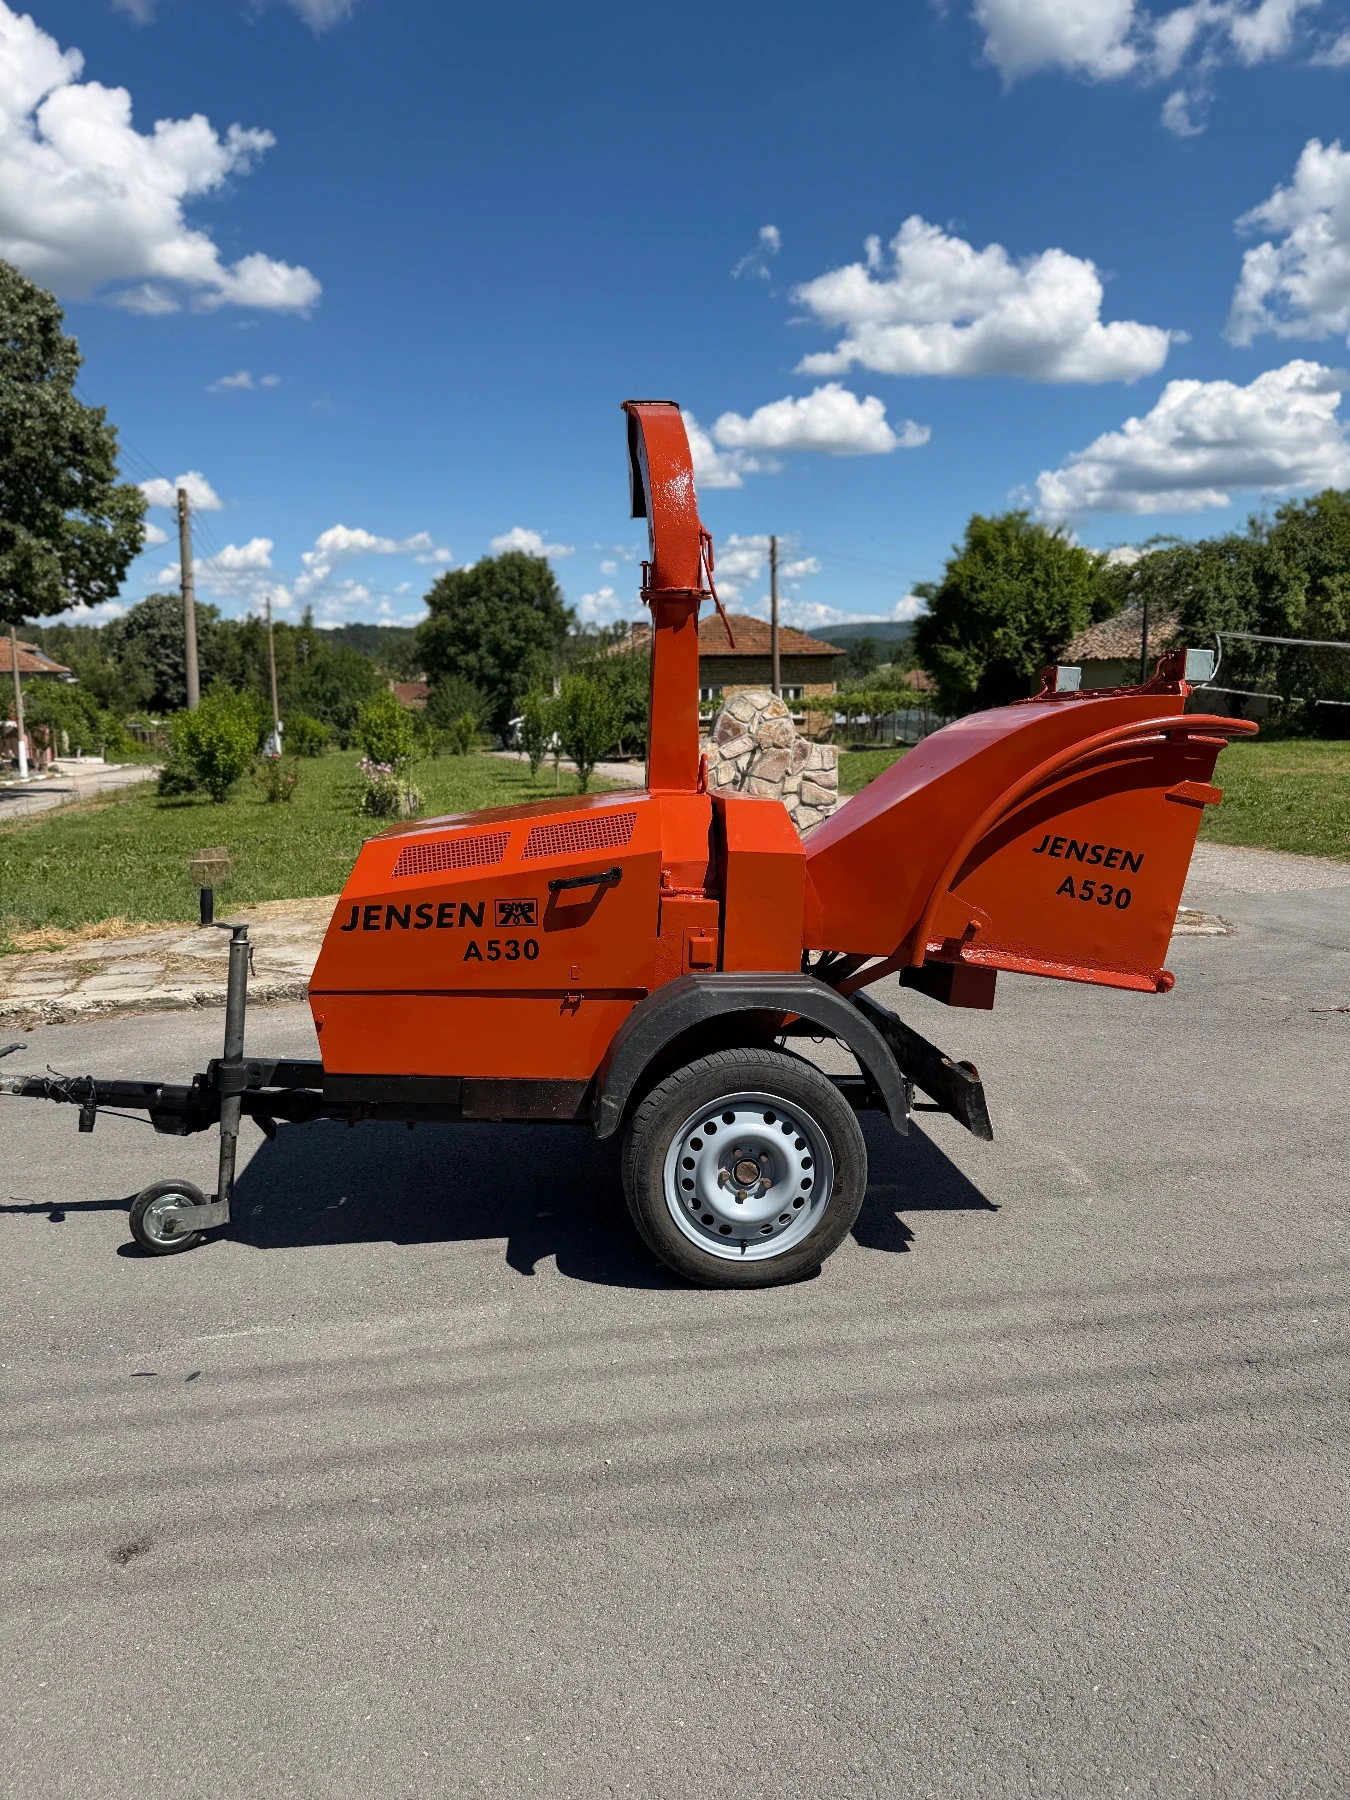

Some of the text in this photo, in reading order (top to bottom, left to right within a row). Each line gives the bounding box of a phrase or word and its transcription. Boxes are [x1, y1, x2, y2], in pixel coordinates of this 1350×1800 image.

[1032, 834, 1145, 873] JENSEN
[1055, 875, 1132, 910] A530
[340, 901, 486, 931] JENSEN
[463, 938, 540, 962] A530
